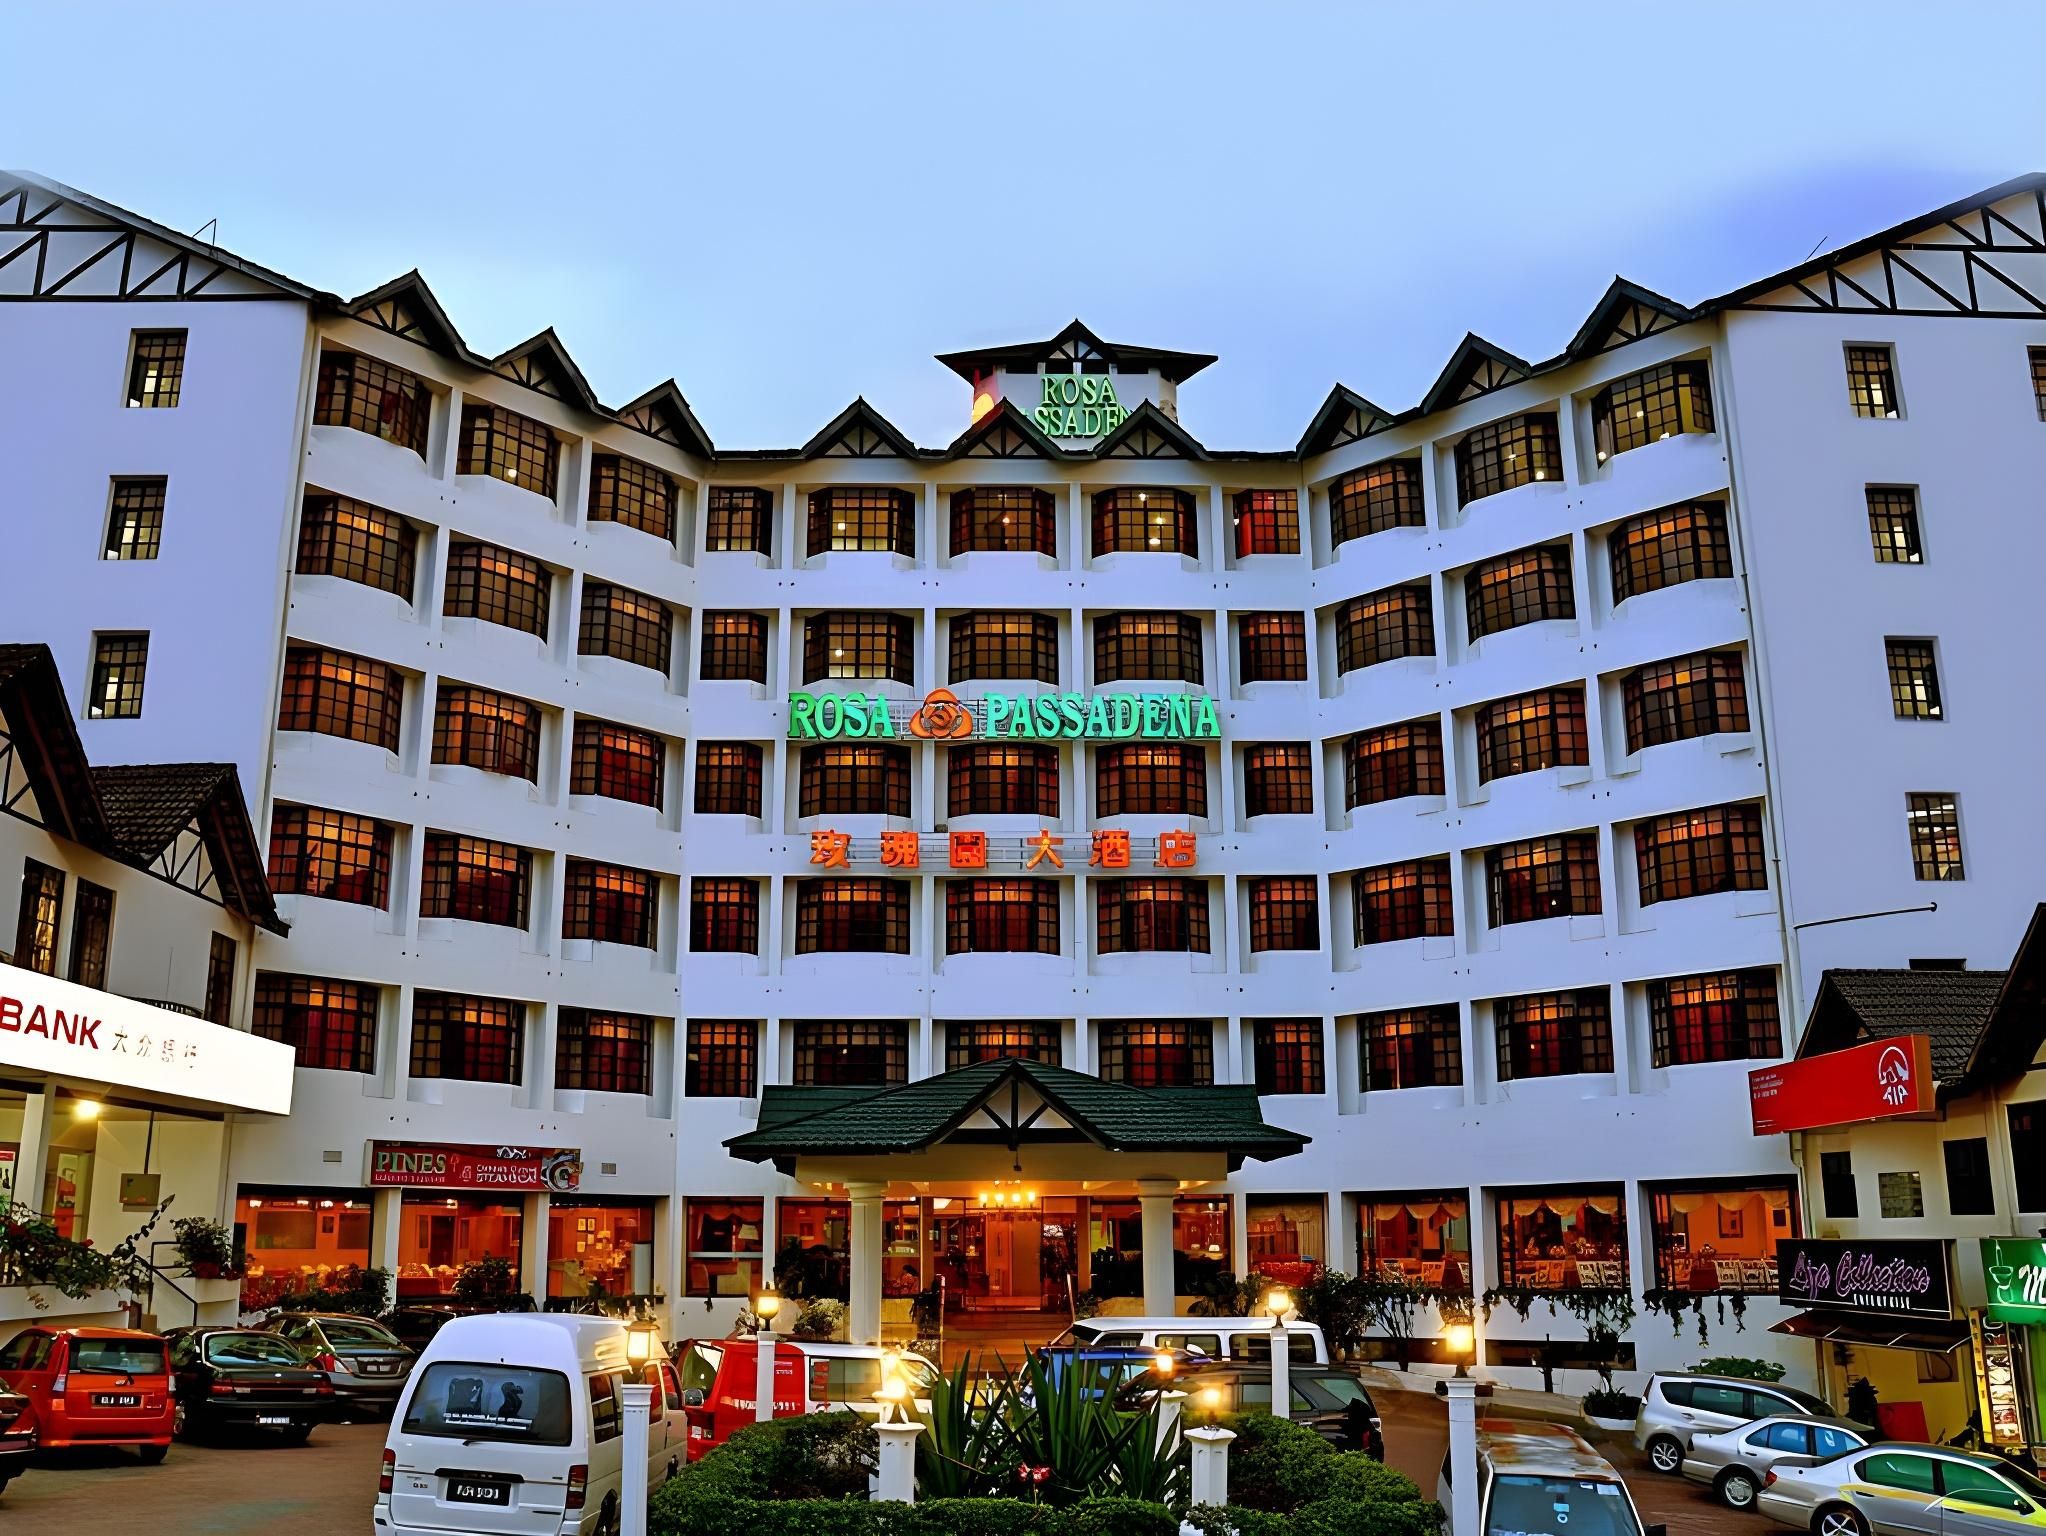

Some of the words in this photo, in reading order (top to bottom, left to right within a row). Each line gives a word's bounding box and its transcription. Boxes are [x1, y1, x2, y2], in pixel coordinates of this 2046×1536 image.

[1041, 376, 1118, 407] ROSA
[1021, 402, 1132, 438] SSADE
[787, 692, 896, 738] ROSA
[984, 692, 1222, 738] PASSADENA
[0, 996, 102, 1050] BANK
[375, 1151, 447, 1174] PINES
